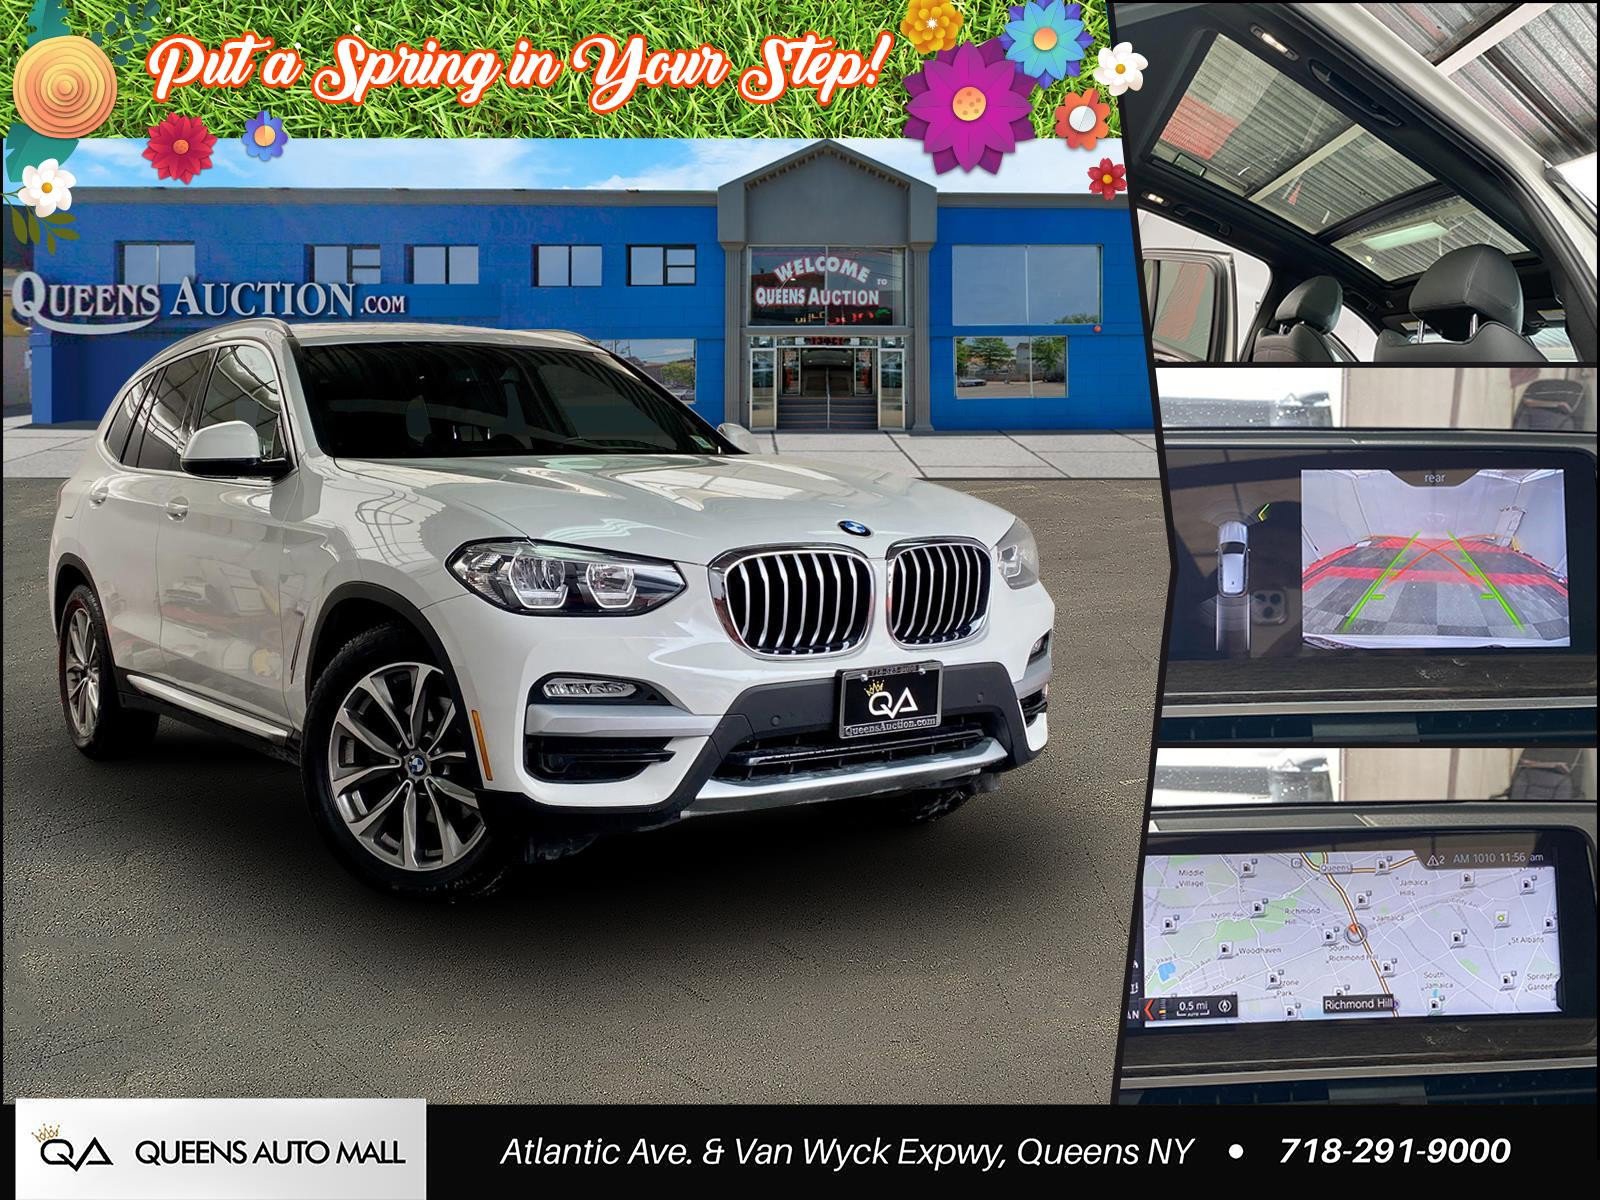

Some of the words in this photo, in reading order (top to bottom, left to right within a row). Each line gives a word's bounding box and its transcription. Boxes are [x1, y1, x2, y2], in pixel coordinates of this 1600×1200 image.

[774, 256, 871, 283] WELCOME
[755, 287, 806, 306] QUEENS
[808, 287, 880, 305] AUCTION
[12, 271, 161, 335] QUEENS
[170, 276, 356, 317] AUCTION
[1424, 474, 1446, 483] rear
[868, 687, 919, 719] QA
[845, 718, 937, 736] QueensAuction.com
[1453, 855, 1471, 864] AM
[1474, 854, 1497, 863] 1010
[1500, 852, 1526, 862] 11:56
[1179, 869, 1204, 877] Middle
[1179, 880, 1204, 889] Village
[1284, 907, 1320, 915] Richmond
[1238, 945, 1283, 955] Woodhaven
[1328, 954, 1365, 962] Richmond
[1423, 970, 1445, 979] South
[1424, 981, 1454, 990] Jamaica
[1276, 990, 1293, 998] Park
[1179, 1001, 1195, 1011] 0.5
[1196, 1001, 1208, 1010] mi
[1324, 998, 1375, 1010] Richmond
[1377, 997, 1394, 1007] Hill
